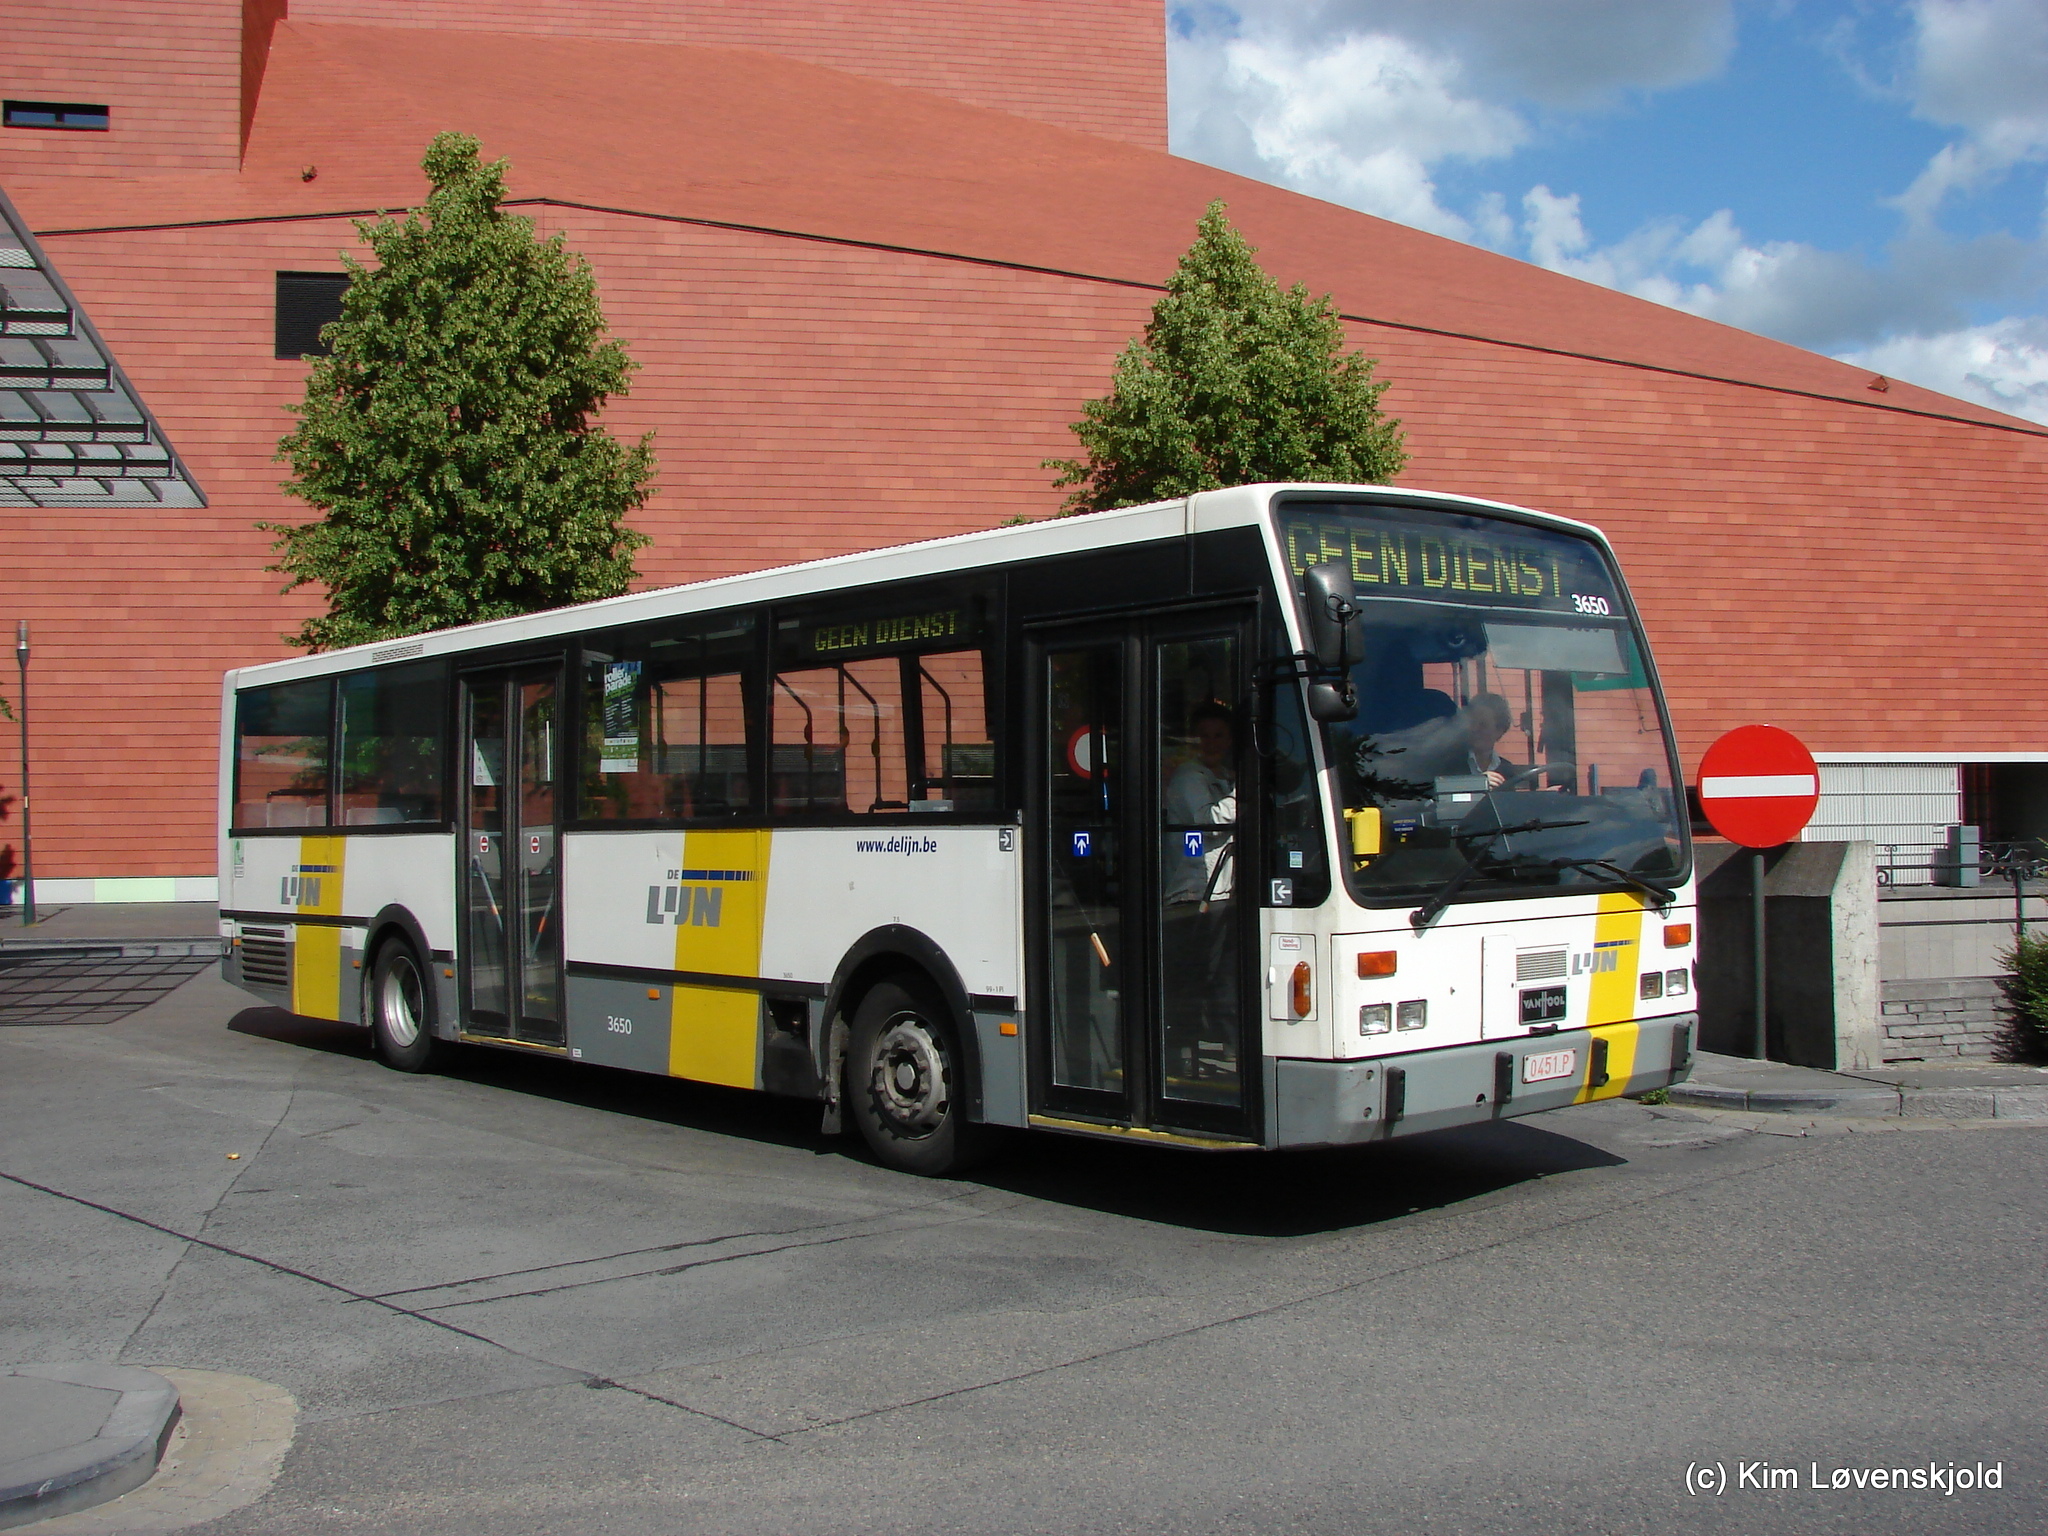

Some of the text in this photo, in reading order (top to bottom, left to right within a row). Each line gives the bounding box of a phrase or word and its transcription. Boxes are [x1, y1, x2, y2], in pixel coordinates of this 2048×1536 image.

[1287, 522, 1561, 598] GEEN DIENST
[1570, 593, 1609, 616] 3650
[814, 610, 959, 651] GEEN DIENST
[605, 672, 632, 697] parade
[856, 835, 937, 857] www.delijn.be
[666, 869, 680, 880] DE
[280, 876, 322, 907] LIJN
[646, 885, 724, 928] LIJN
[1571, 949, 1619, 976] LIJN
[607, 1015, 632, 1035] 3650
